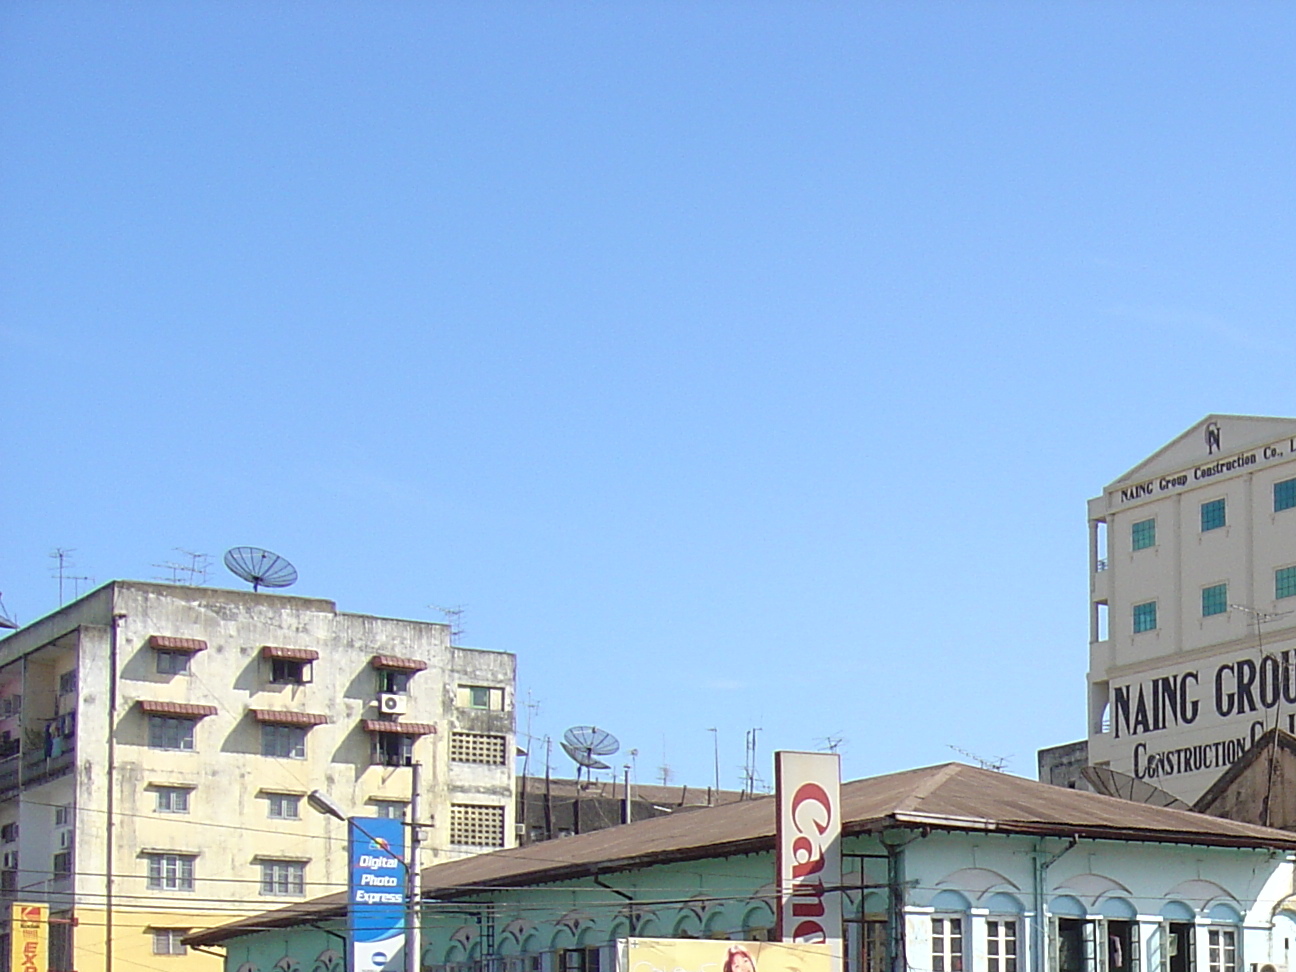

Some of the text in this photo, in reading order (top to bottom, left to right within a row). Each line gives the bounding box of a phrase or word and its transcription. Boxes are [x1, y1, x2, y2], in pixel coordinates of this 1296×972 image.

[1120, 481, 1153, 503] NAING
[1159, 473, 1188, 491] Group
[1194, 452, 1257, 481] Construction
[1263, 445, 1284, 460] Co.,
[1114, 670, 1199, 739] NAING
[359, 854, 399, 870] Digital
[361, 873, 398, 887] Photo
[355, 889, 403, 905] Express
